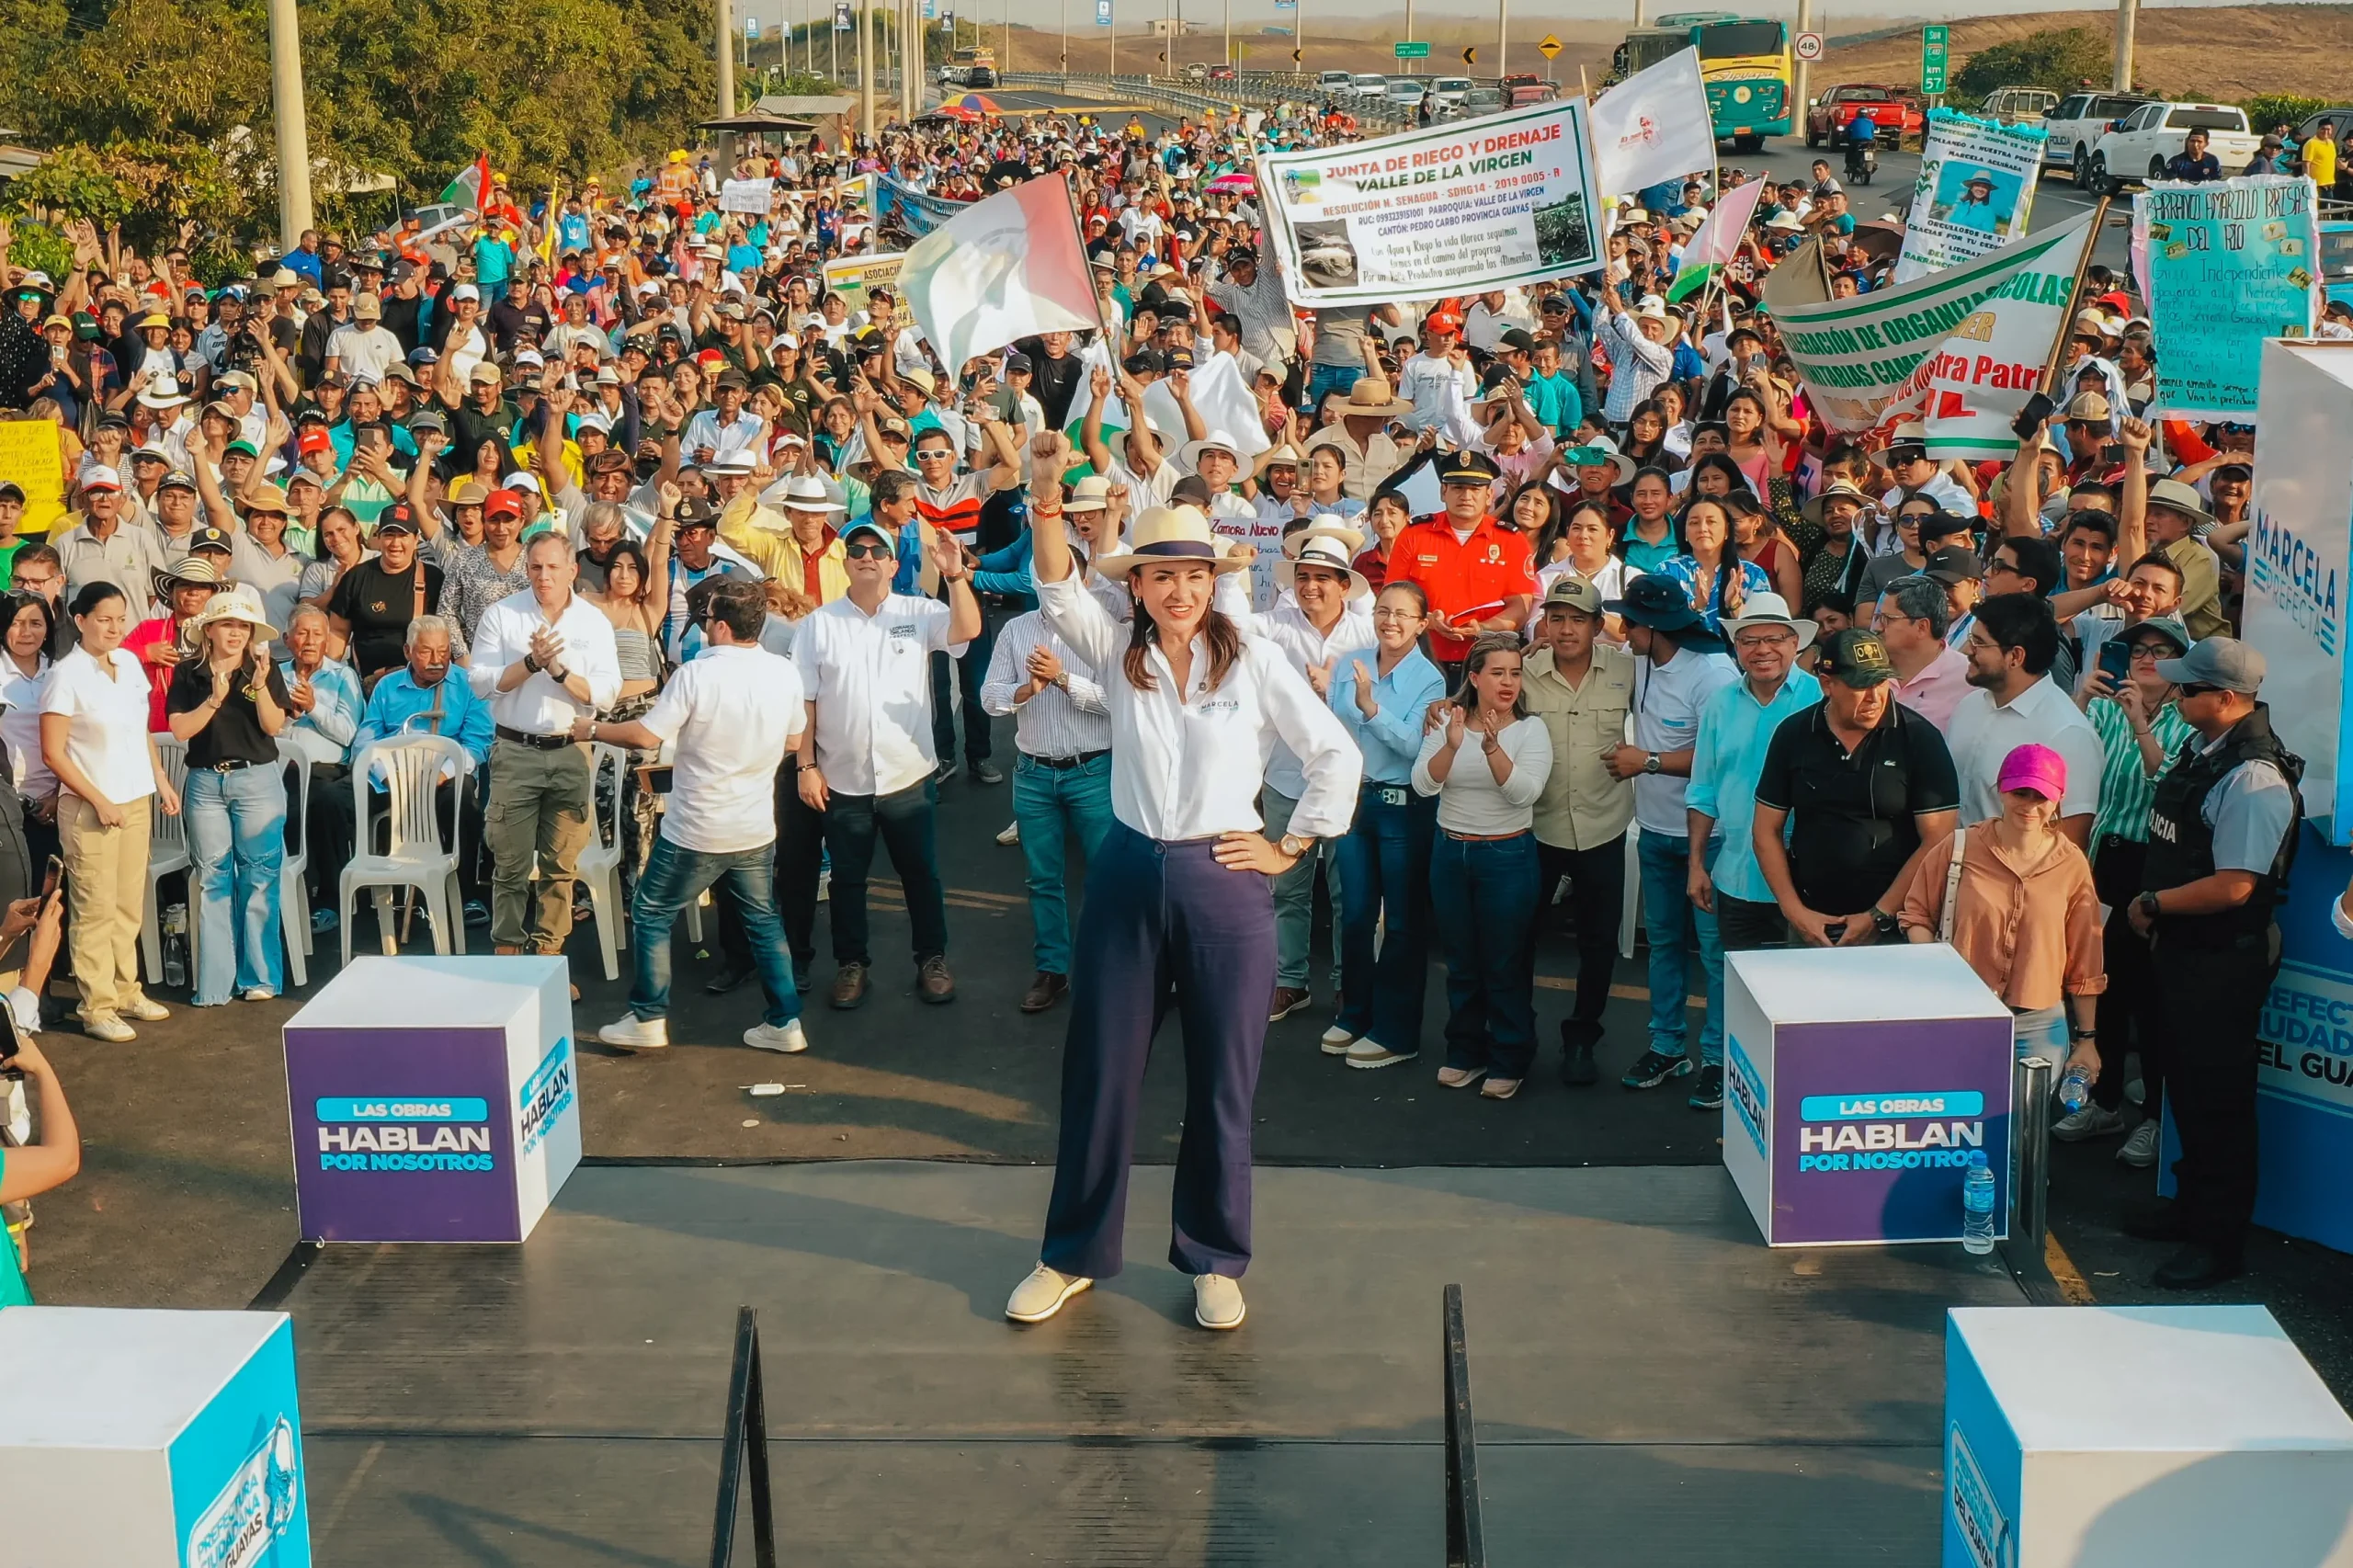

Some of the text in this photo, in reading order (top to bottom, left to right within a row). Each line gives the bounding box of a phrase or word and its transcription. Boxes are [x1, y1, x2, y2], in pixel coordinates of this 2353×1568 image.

[1927, 65, 1941, 74] km
[1925, 77, 1942, 90] 57
[1326, 124, 1561, 179] JUNTA DE RIEGO Y DRENAJE
[1355, 150, 1533, 193] VALLE DE LA VIRGEN
[1323, 197, 1381, 217] RESOLUCIÓN
[1495, 176, 1519, 191] 2019
[1474, 197, 1496, 208] VALLE
[1497, 193, 1507, 204] DE
[1508, 191, 1518, 202] LA
[1518, 186, 1545, 199] VIRGEN
[1410, 219, 1434, 232] PEDRO
[1435, 215, 1460, 228] CARBO
[1461, 208, 1501, 224] PROVINCIA
[1502, 202, 1529, 217] GUAYAS
[2186, 226, 2211, 252] DEL
[1857, 324, 1887, 351] DE
[2256, 507, 2336, 619] MARCELA
[2265, 568, 2321, 642] PREFECTA
[1202, 700, 1239, 710] MARCELA
[353, 1103, 452, 1118] LAS OBRAS
[520, 1062, 570, 1142] HABLAN
[1728, 1059, 1765, 1142] HABLAN
[1839, 1098, 1945, 1116] LAS OBRAS
[318, 1127, 491, 1153] HABLAN
[1800, 1121, 1984, 1153] HABLAN
[320, 1153, 494, 1171] POR NOSOTROS
[1800, 1153, 1850, 1173] POR
